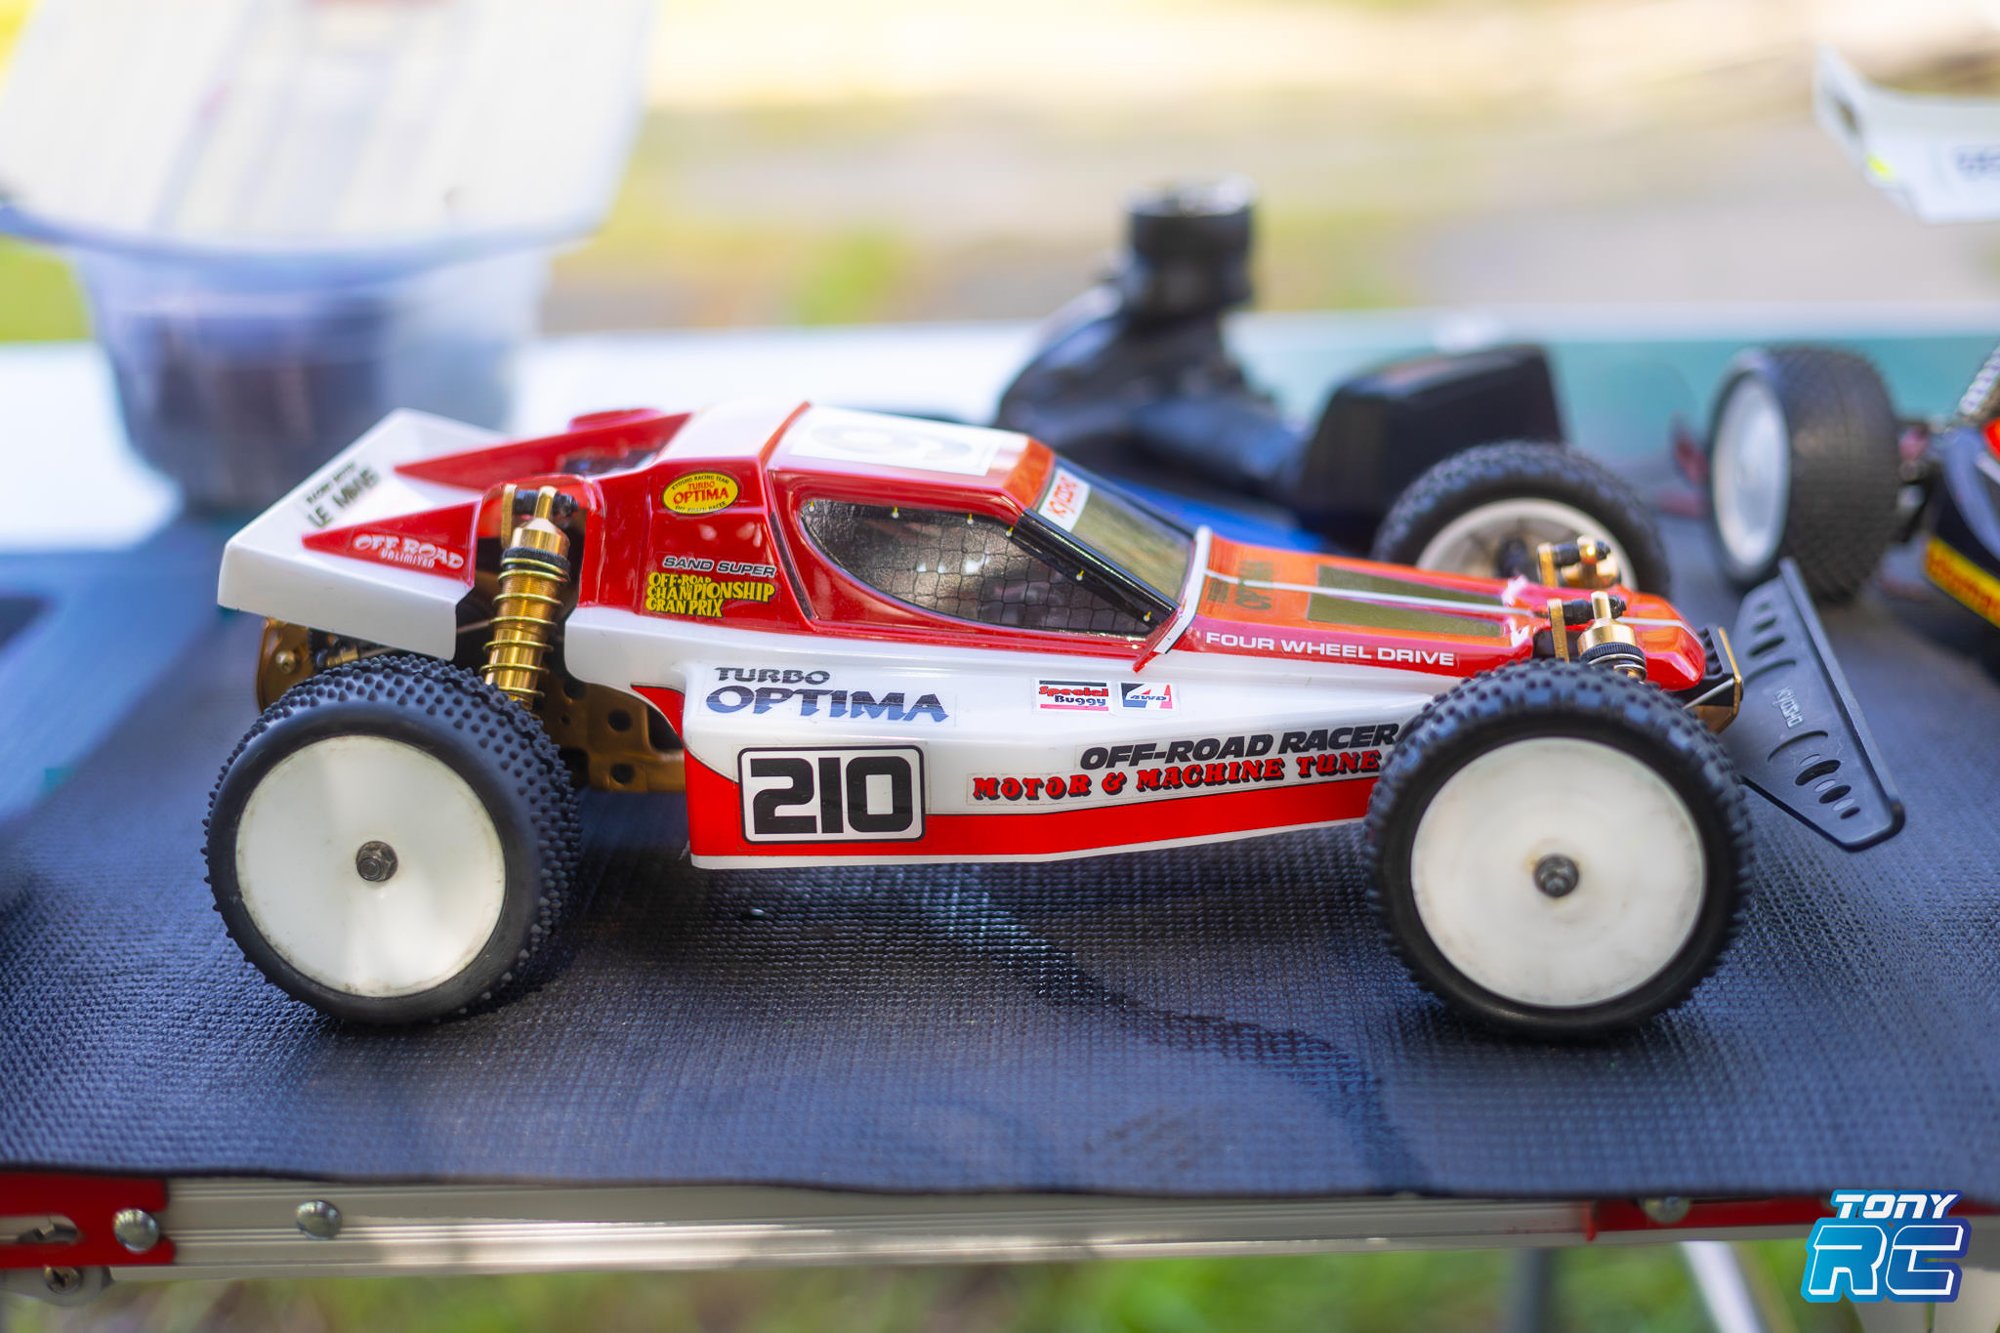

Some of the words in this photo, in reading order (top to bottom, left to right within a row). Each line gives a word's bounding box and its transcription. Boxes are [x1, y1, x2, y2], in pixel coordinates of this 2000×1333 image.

[673, 486, 729, 504] OPTIMA
[688, 481, 715, 489] TURBO
[354, 534, 400, 551] OFF
[402, 537, 464, 570] ROAD
[663, 556, 714, 571] SAND
[717, 561, 777, 578] SUPER
[647, 581, 776, 603] CHAMPIONSHIP
[688, 599, 724, 617] PRIX
[1206, 632, 1275, 650] FOUR
[1281, 639, 1371, 661] WHEEL
[1377, 647, 1455, 667] DRIVE
[714, 667, 831, 685] TURBO
[1038, 685, 1109, 697] Special
[1054, 695, 1107, 706] Buggy
[706, 685, 950, 722] OPTIMA
[1080, 734, 1274, 770] OFF-ROAD
[1278, 723, 1400, 755] RACER
[972, 774, 1092, 801] MOTOR
[1101, 771, 1127, 795] &
[1136, 758, 1285, 792] MACHINE
[750, 756, 914, 835] 210
